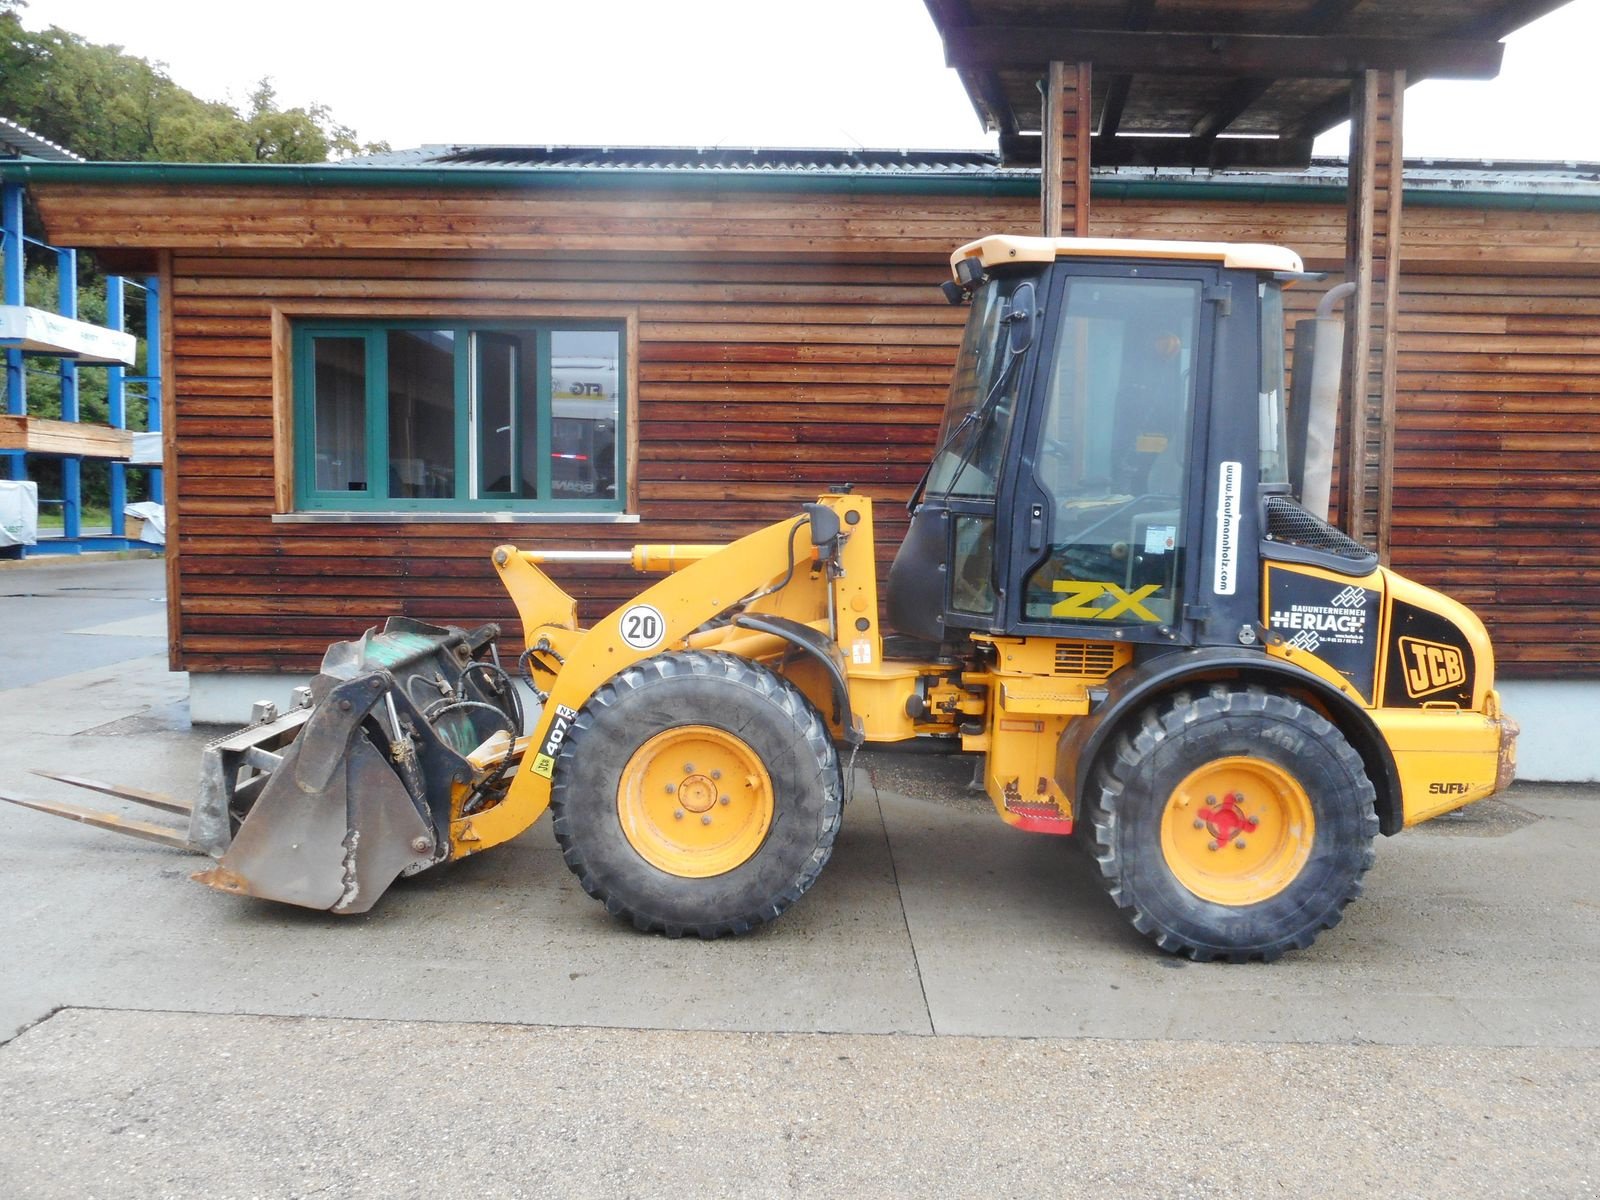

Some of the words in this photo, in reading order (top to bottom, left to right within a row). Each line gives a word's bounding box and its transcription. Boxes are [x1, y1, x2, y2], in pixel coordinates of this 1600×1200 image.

[1220, 465, 1234, 590] www.kaufmannholz.com
[1052, 580, 1163, 622] ZX
[1291, 605, 1366, 616] BAUUNTERNEHMEN
[628, 615, 656, 639] 20
[1270, 611, 1366, 632] HERLACH
[1409, 643, 1461, 691] JCB
[546, 717, 567, 755] 407
